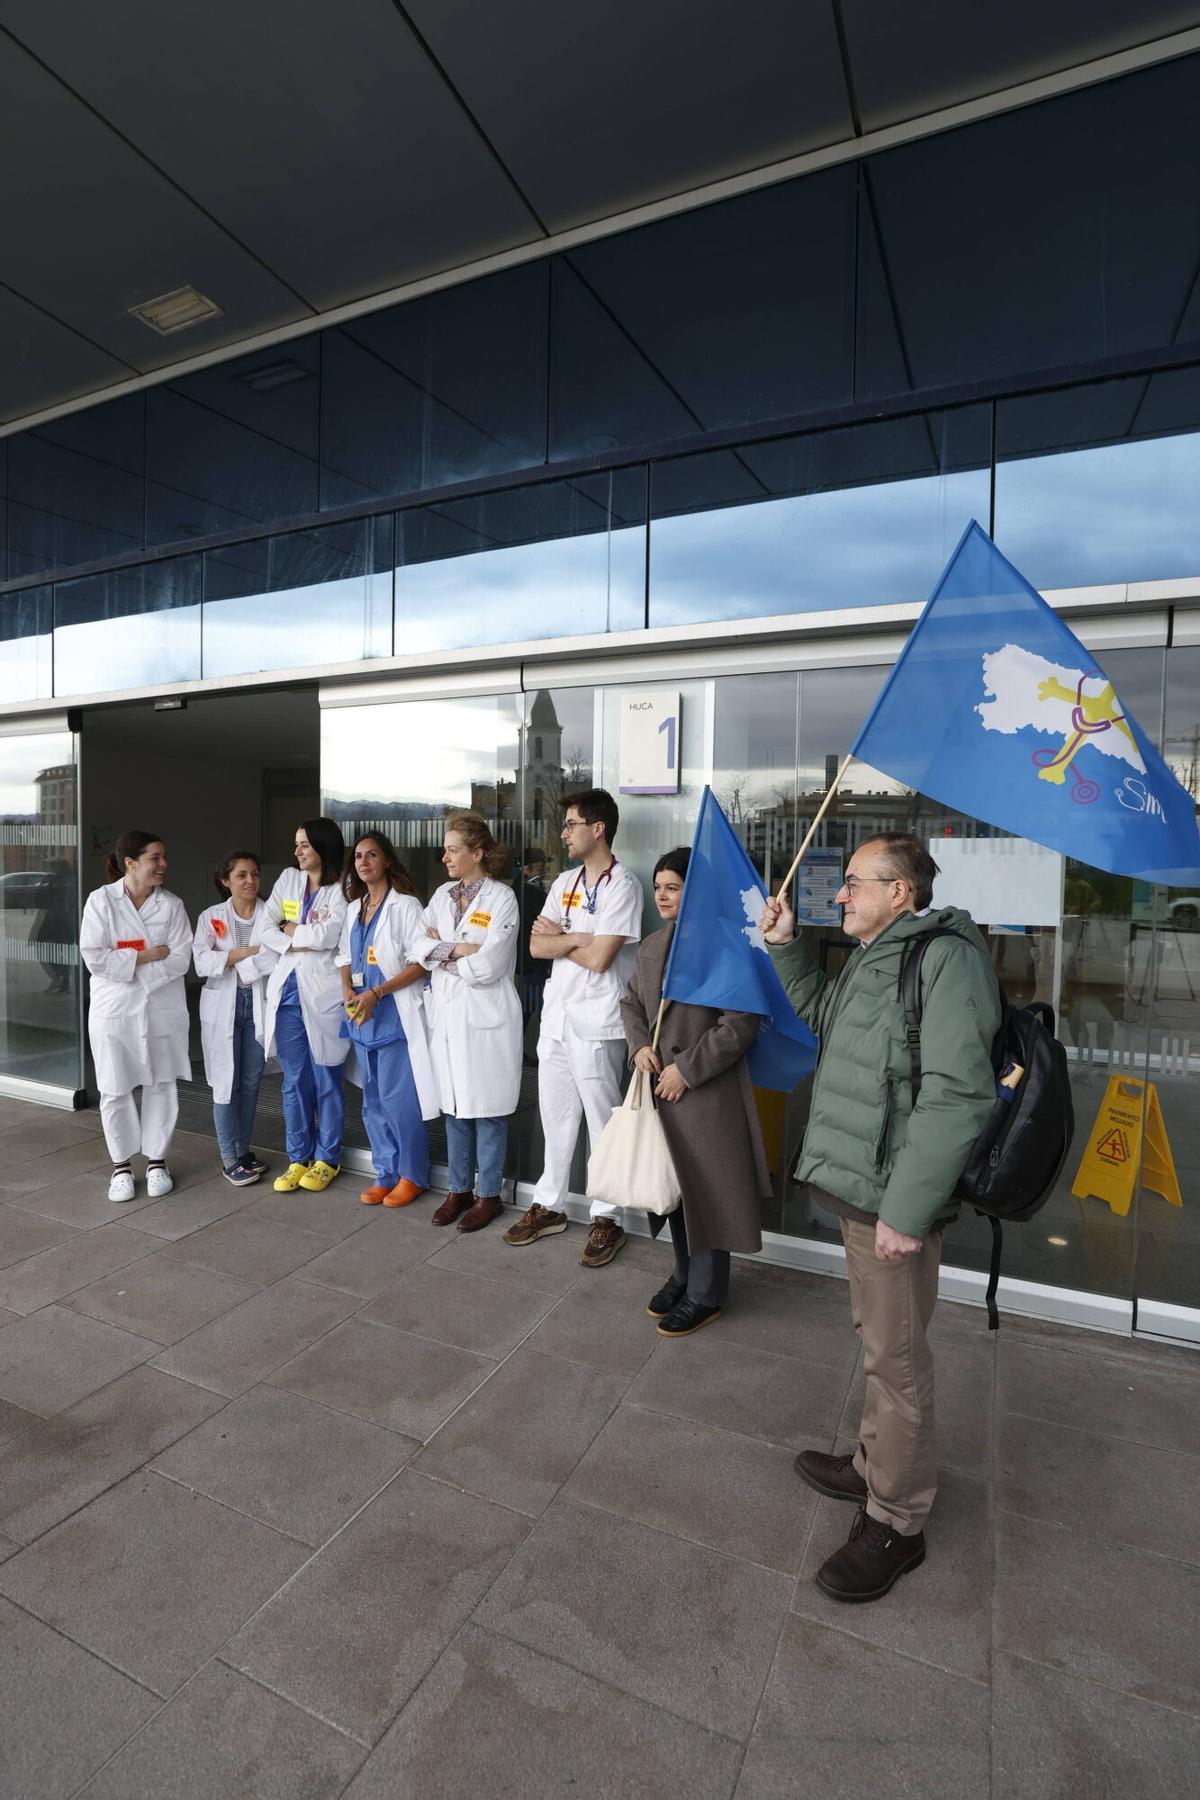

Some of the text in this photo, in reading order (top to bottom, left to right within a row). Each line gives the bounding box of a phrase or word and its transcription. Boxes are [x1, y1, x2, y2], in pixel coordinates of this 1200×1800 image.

[629, 702, 654, 711] HUCA
[658, 716, 676, 769] 1
[1110, 1116, 1135, 1128] MOJADO
